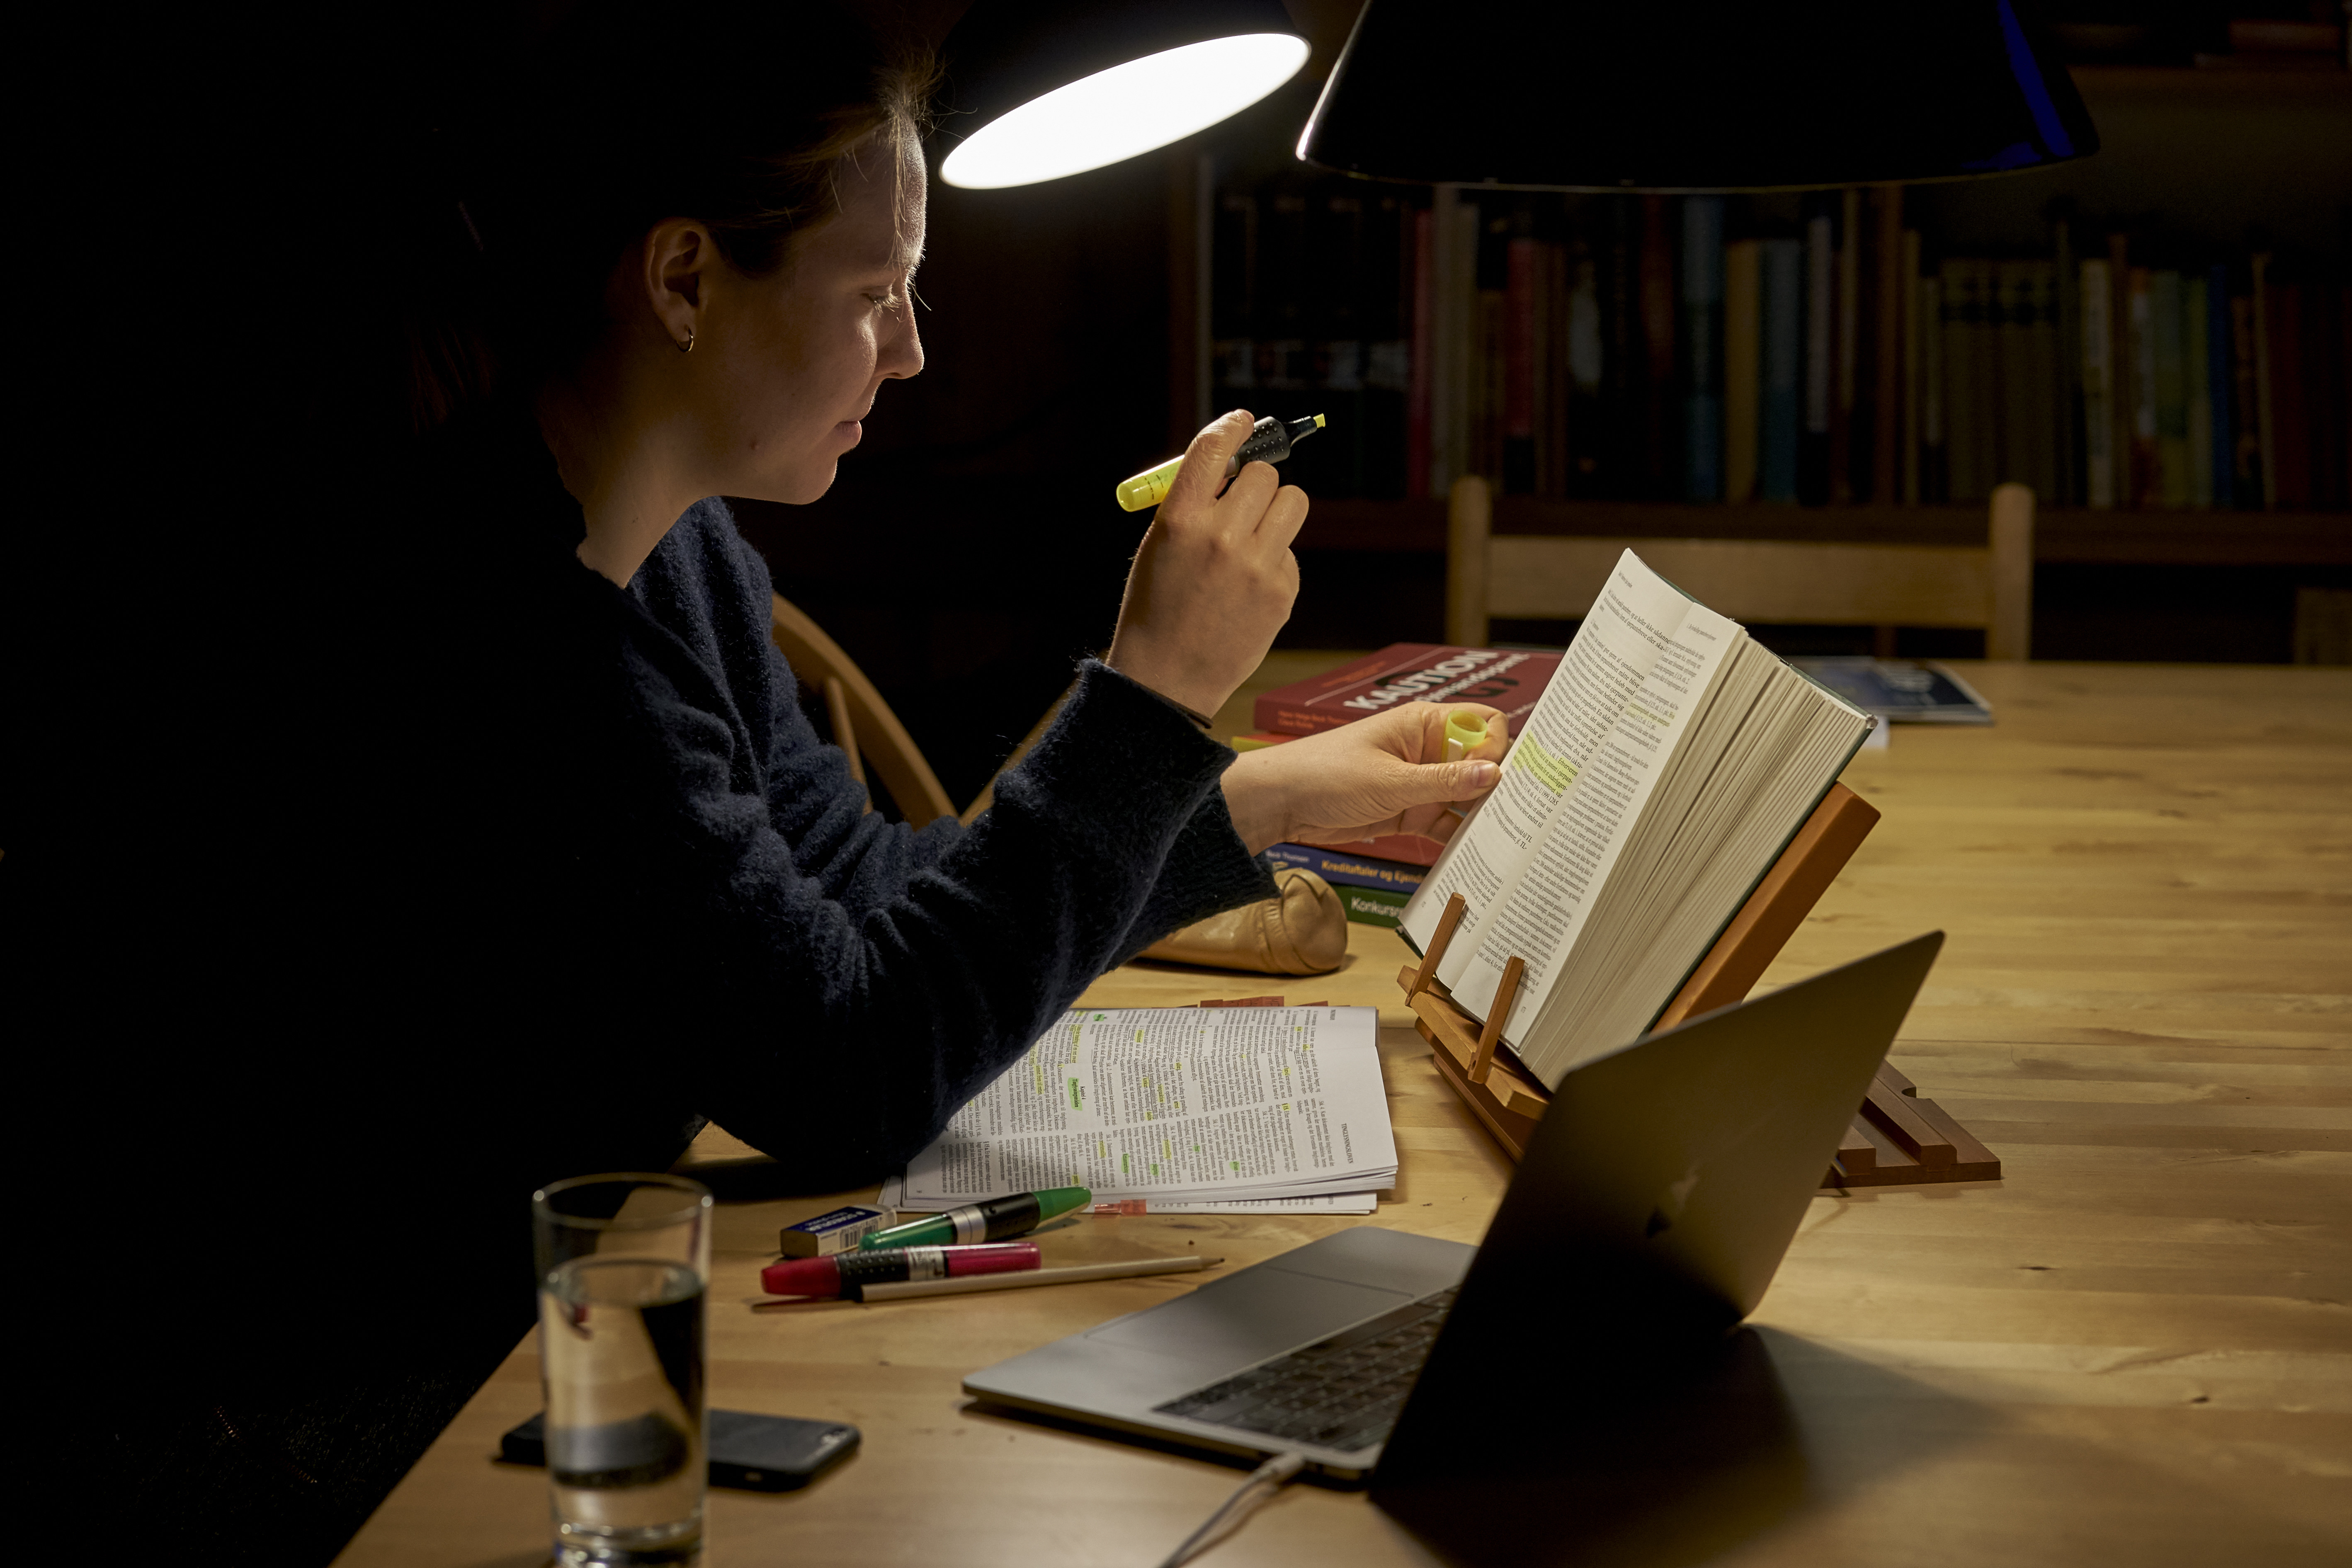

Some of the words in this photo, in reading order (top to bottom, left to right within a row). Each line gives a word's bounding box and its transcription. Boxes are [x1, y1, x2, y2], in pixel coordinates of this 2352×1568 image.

[1626, 620, 1647, 638] ejerpantebreve
[1647, 636, 1656, 644] eller
[1637, 617, 1646, 626] heller
[1646, 623, 1654, 632] ikke
[1653, 630, 1671, 644] sådanne
[1600, 655, 1619, 673] ejerpantebrevet
[1618, 671, 1629, 680] måtte
[1629, 677, 1640, 688] blive
[1621, 661, 1645, 681] ejendommen
[1344, 650, 1500, 710] KAUTION
[1604, 671, 1615, 681] angivet
[1614, 677, 1625, 688] beløb
[1590, 694, 1602, 704] fiktion
[1595, 684, 1604, 695] fortsat
[1603, 692, 1618, 705] befinder
[1610, 687, 1629, 702] ejerpante-
[1581, 698, 1597, 712] pengebeløb.
[1602, 714, 1614, 725] sådan
[1572, 725, 1589, 741] forbeholdt,
[1581, 720, 1598, 735] (oprettelse
[1596, 721, 1608, 731] udste-
[1561, 750, 1572, 760] dennes
[1571, 757, 1583, 768] (aktu-
[1558, 758, 1578, 777] Erhververen
[1548, 774, 1567, 790] underliggen-
[1558, 770, 1572, 783] ejerpan-
[1539, 778, 1556, 793] pantebrevet
[1536, 797, 1546, 808] fortsat
[1541, 790, 1559, 806] 1999.1285
[1527, 814, 1538, 825] ændret
[1536, 810, 1547, 820] almin-
[1341, 1123, 1353, 1163] TINGLYSNINGSLOVEN
